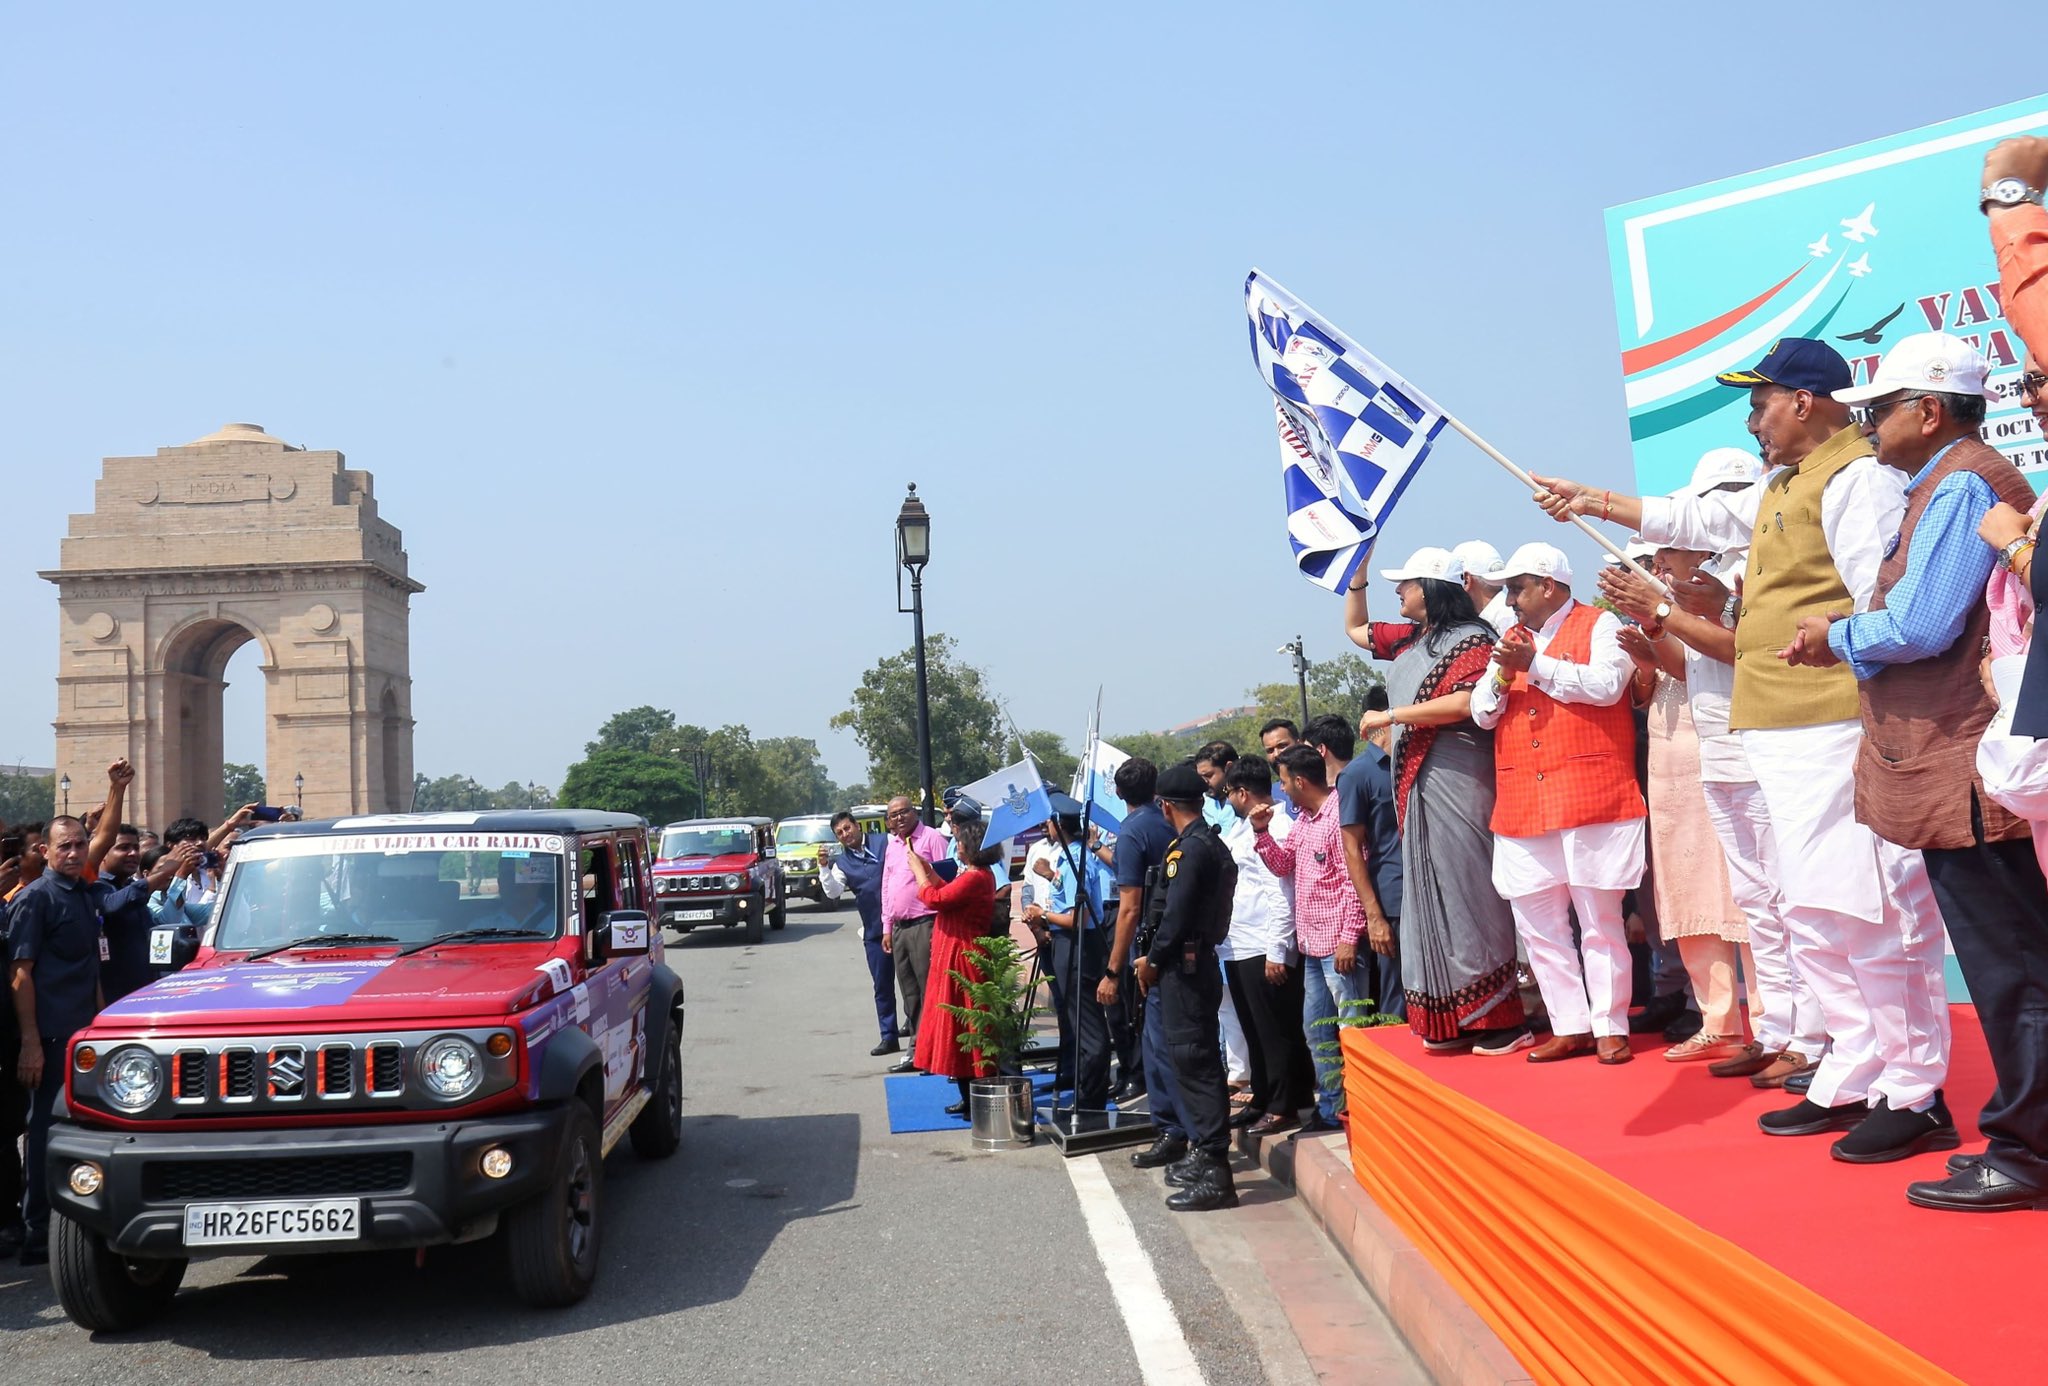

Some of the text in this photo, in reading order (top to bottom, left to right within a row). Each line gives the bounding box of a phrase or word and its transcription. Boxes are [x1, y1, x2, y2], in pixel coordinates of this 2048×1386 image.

[1996, 418, 2034, 438] OCT
[1359, 432, 1384, 458] MMG
[190, 482, 238, 497] INDIA
[374, 836, 436, 849] VIJETA
[443, 836, 479, 849] CAR
[487, 836, 544, 849] RALLY
[569, 850, 578, 911] NHIDCL
[203, 1208, 355, 1237] HR26FC5662
